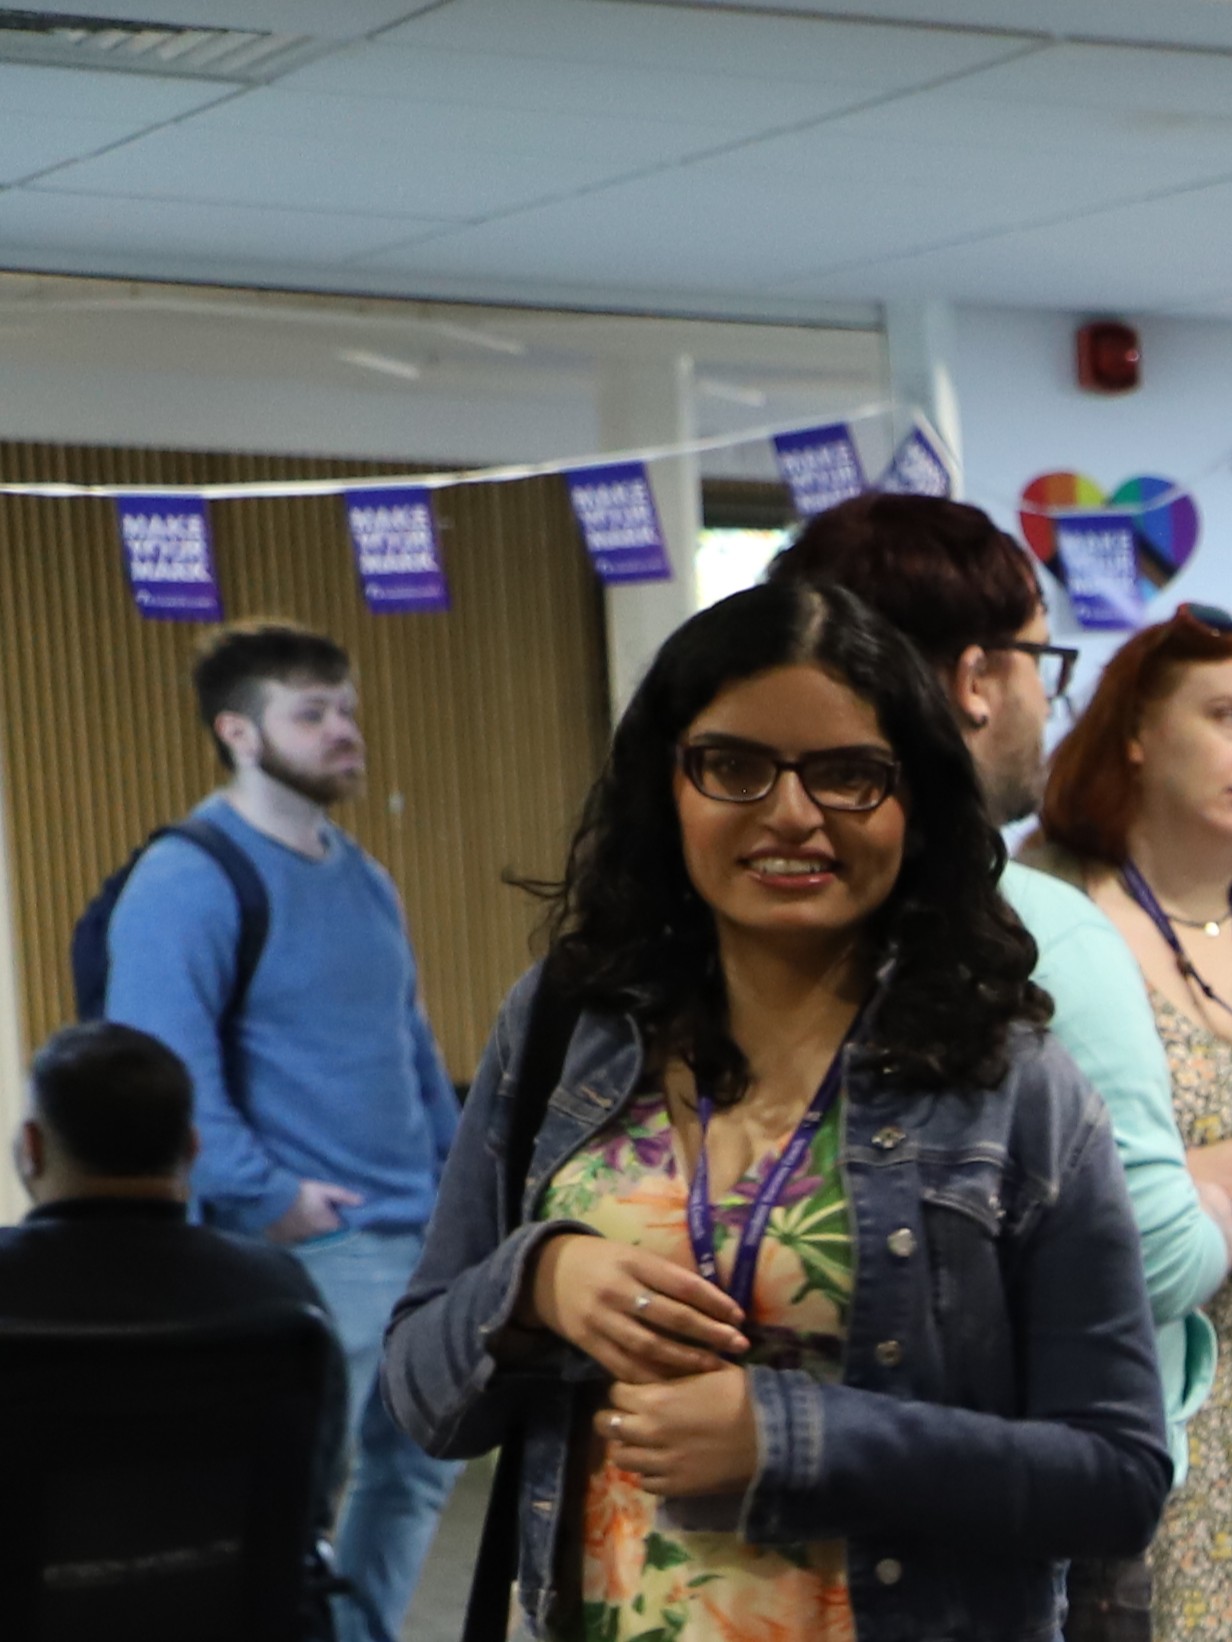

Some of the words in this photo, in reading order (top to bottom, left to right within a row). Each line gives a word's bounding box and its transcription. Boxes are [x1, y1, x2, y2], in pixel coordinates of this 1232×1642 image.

[571, 479, 649, 513] MAKE
[122, 513, 204, 542] MAKE
[350, 503, 432, 534] MAKE
